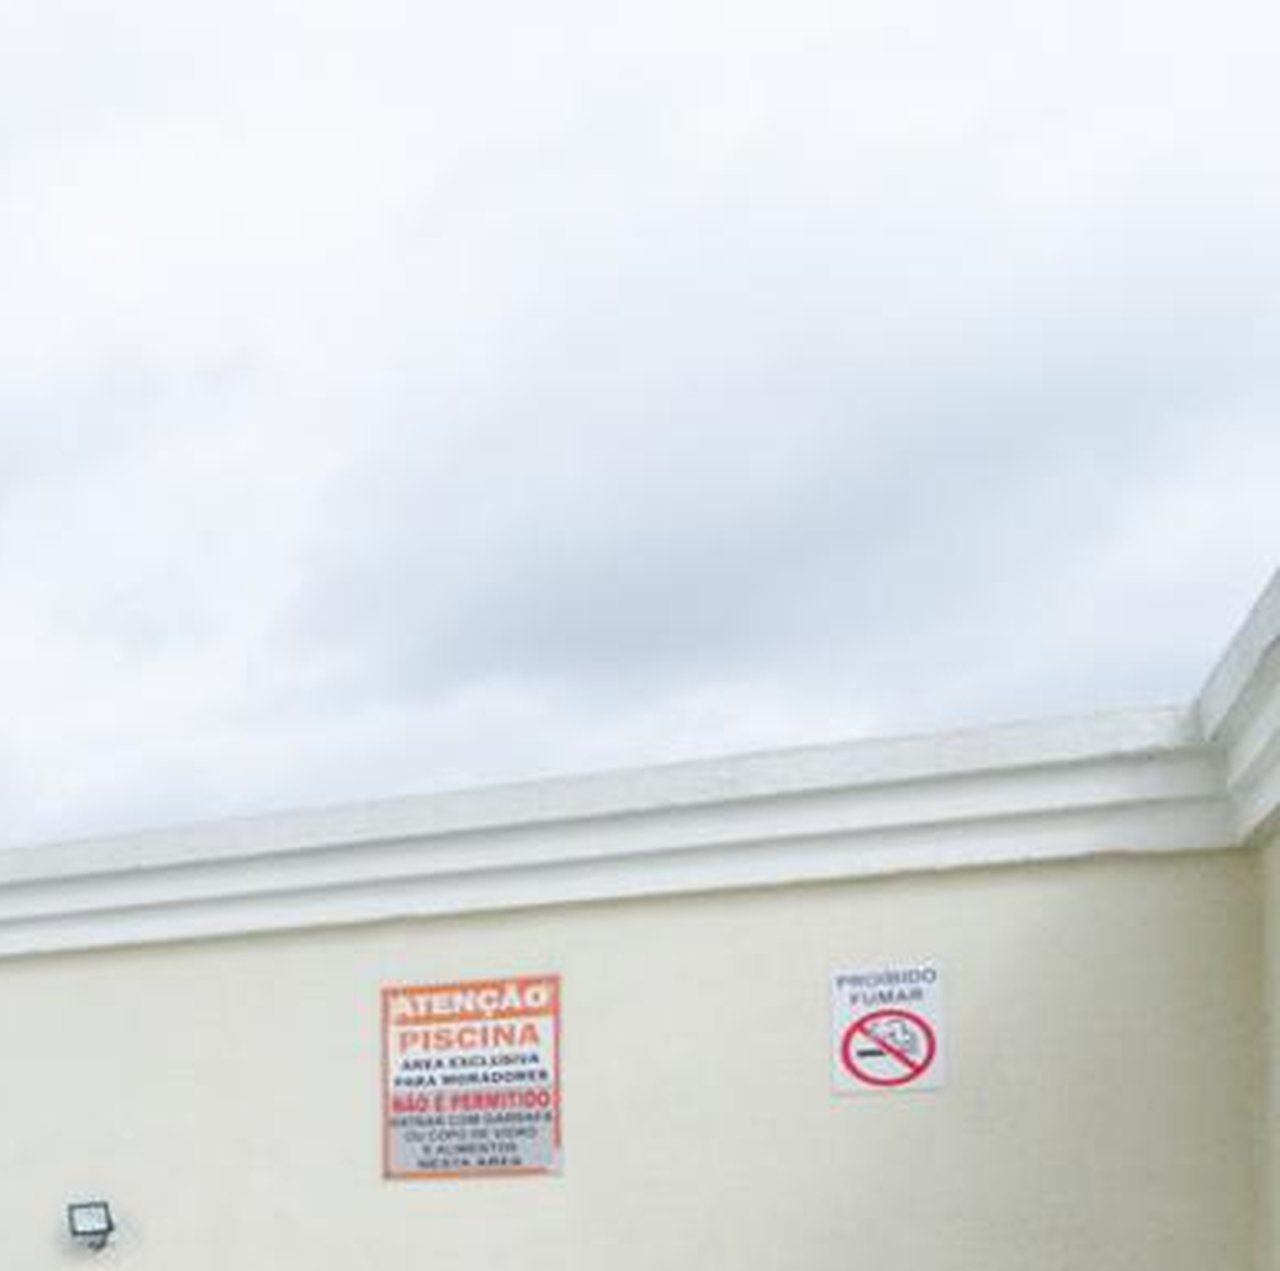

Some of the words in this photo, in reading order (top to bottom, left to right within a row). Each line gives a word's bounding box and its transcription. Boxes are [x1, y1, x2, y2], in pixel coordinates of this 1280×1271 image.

[836, 967, 937, 990] PROIBIDO
[850, 986, 924, 1006] FUMAR
[399, 1023, 539, 1051] PISCINA
[448, 1053, 540, 1068] EXCLUSIVA
[394, 1074, 437, 1087] PARA
[441, 1070, 548, 1086] MORADORES
[451, 1089, 550, 1111] PERMITIDO
[448, 1112, 480, 1126] COM
[404, 1130, 424, 1143] OU
[428, 1128, 466, 1143] COPO
[470, 1128, 488, 1140] DE
[493, 1126, 538, 1140] VIDRO
[435, 1142, 518, 1155] ALIMENTOS
